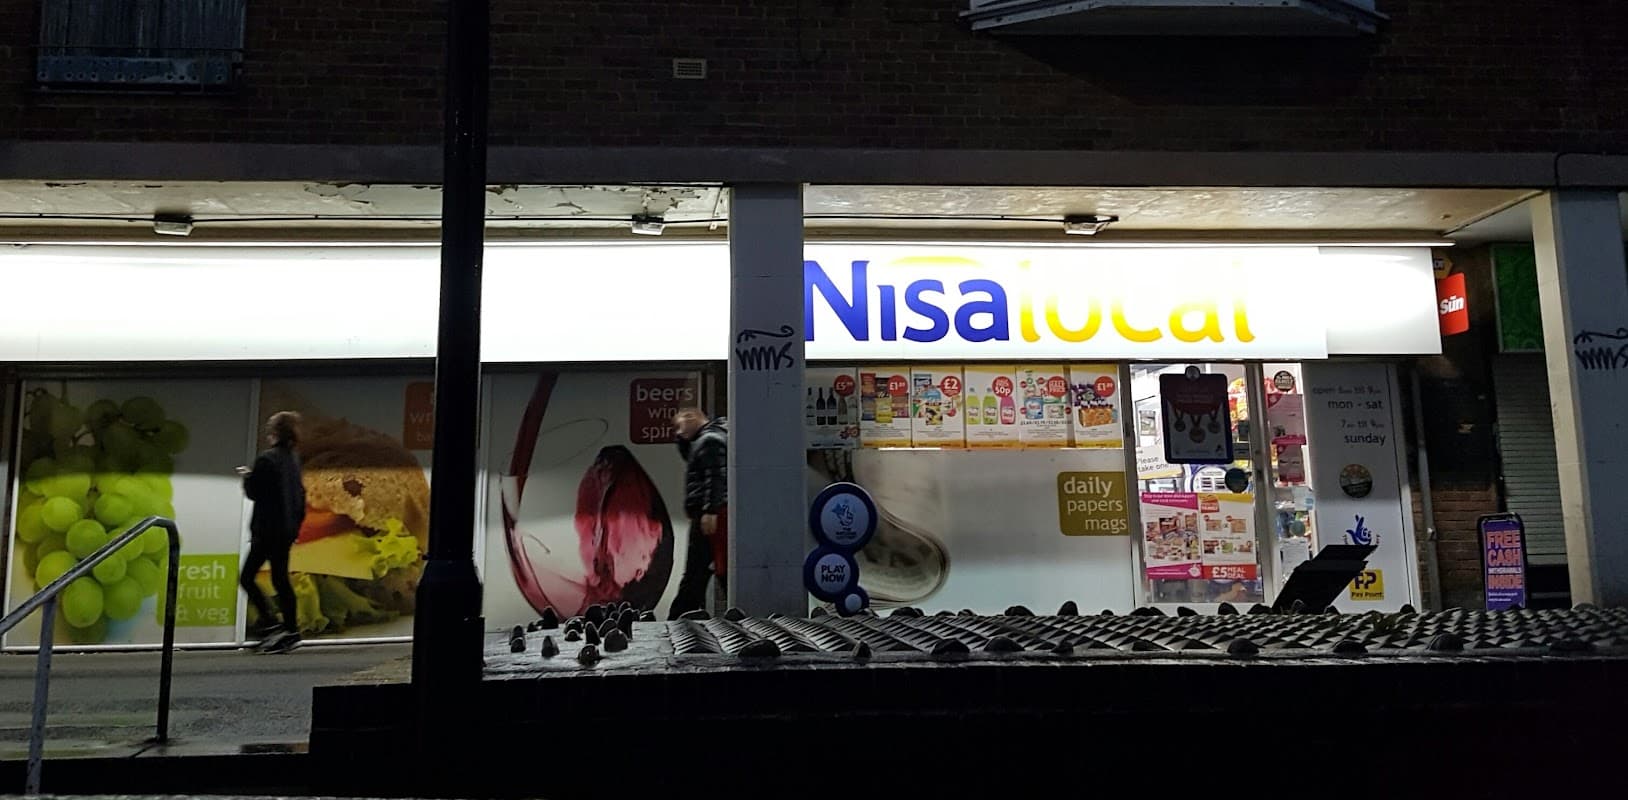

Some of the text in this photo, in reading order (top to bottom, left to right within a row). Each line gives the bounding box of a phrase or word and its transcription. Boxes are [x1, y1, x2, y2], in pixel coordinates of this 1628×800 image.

[804, 260, 1010, 343] Nisa
[943, 378, 958, 390] £2
[994, 386, 1011, 396] 50p
[636, 384, 694, 402] beers
[647, 404, 677, 419] win
[1328, 400, 1353, 409] mon
[1365, 400, 1383, 409] sat
[641, 423, 673, 443] spir
[1344, 432, 1386, 446] sunday
[1063, 476, 1112, 498] daily
[1067, 500, 1124, 516] papers
[1085, 518, 1127, 534] mags
[1486, 529, 1521, 549] FREE
[1487, 548, 1521, 567] CASH
[177, 560, 226, 580] resh
[821, 564, 846, 574] PLAY
[1211, 566, 1227, 578] £5
[821, 574, 846, 583] NOW
[1487, 574, 1522, 590] INSIDE
[178, 584, 221, 599] fruit
[196, 608, 229, 625] veg
